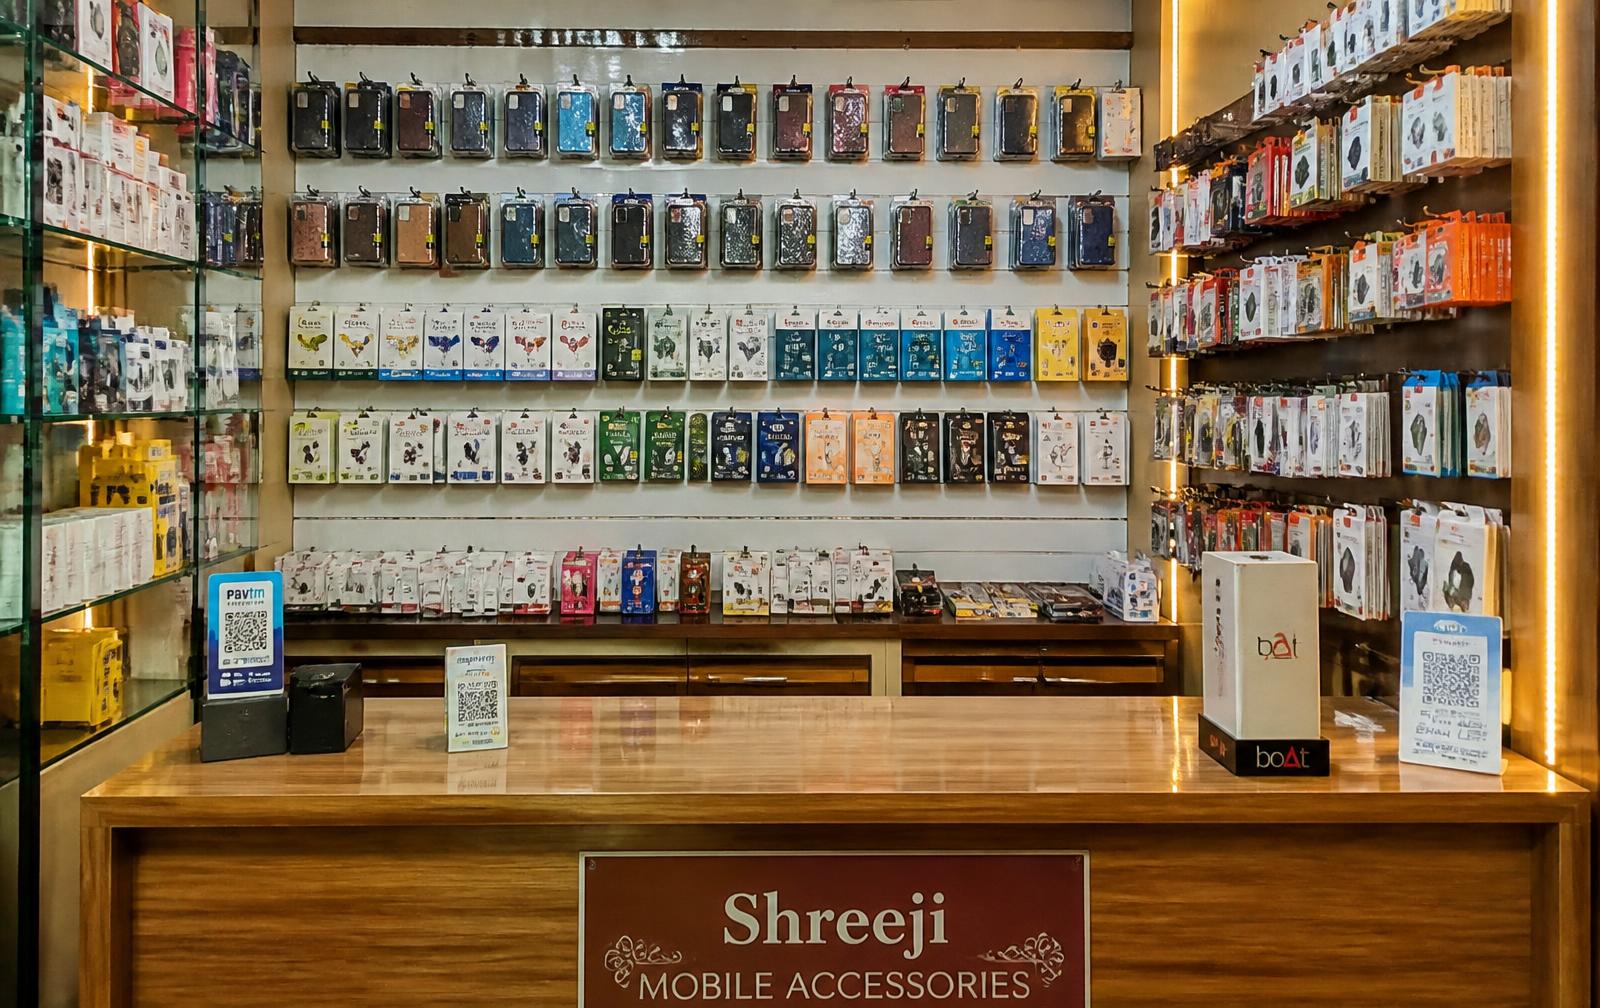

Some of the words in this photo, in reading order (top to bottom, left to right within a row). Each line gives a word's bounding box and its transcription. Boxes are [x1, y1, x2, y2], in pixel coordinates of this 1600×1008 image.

[724, 891, 949, 959] Shreeji
[639, 972, 774, 1000] MOBILE
[786, 972, 1031, 1000] ACCESSORIES
